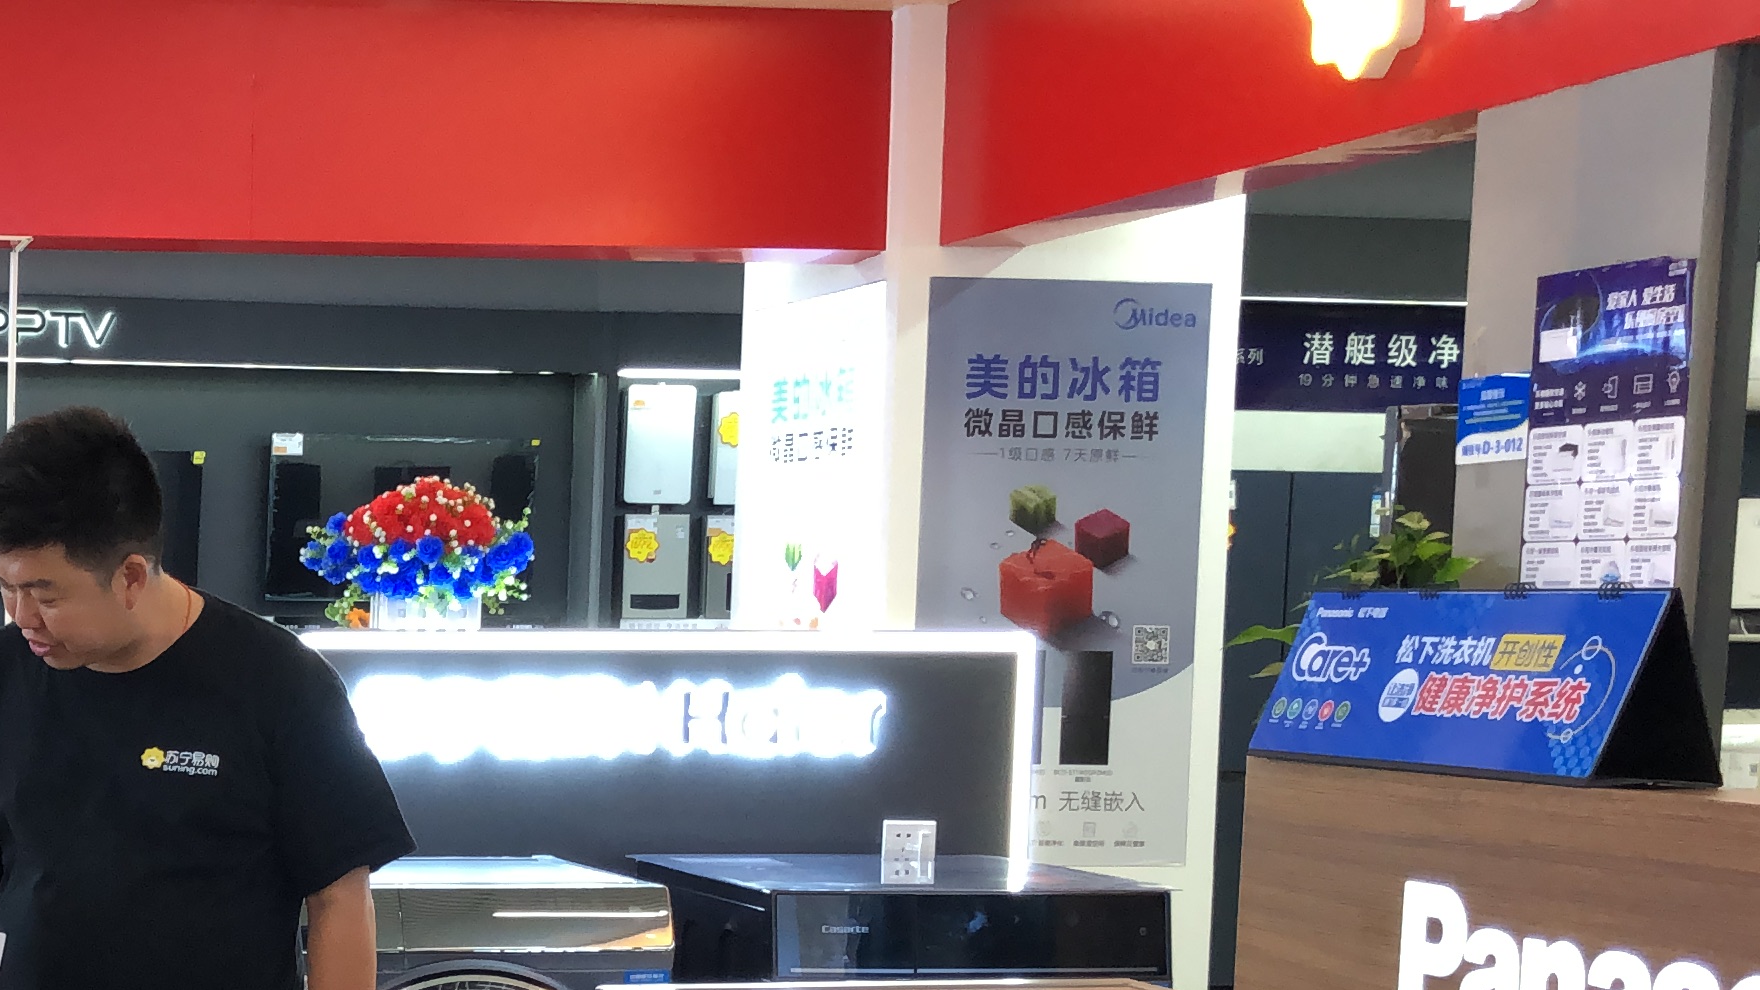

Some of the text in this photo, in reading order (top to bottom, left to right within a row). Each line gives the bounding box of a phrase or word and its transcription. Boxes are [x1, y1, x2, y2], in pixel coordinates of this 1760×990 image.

[1120, 303, 1197, 329] Midea
[1303, 331, 1460, 369] 潜艇级净
[965, 353, 1162, 402] 美的冰箱
[963, 408, 1159, 441] 微晶口感保鲜
[1292, 631, 1371, 684] Care+
[1395, 634, 1558, 668] 松下洗衣机 开创性
[1411, 671, 1592, 725] 健康净护系统
[163, 764, 218, 777] suning.com
[165, 750, 220, 769] 苏宁易购
[1058, 790, 1145, 812] 无缝嵌入
[821, 924, 870, 934] Casarte
